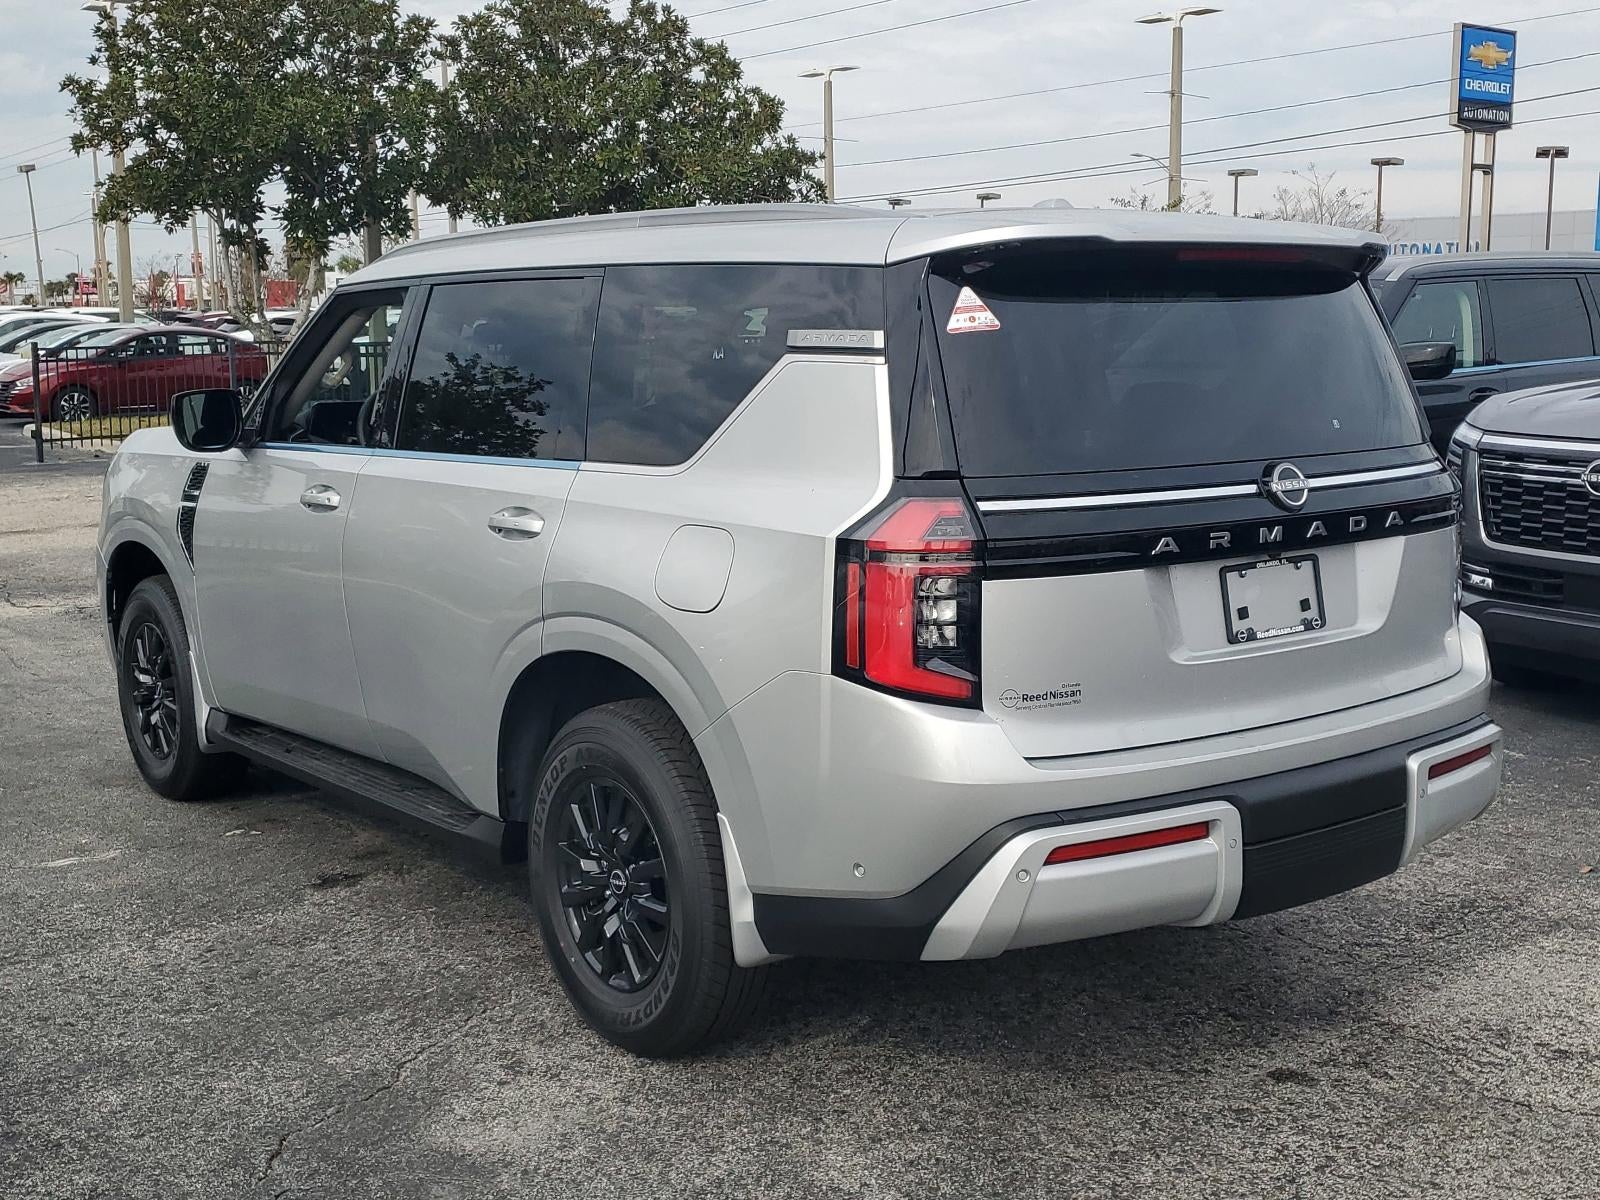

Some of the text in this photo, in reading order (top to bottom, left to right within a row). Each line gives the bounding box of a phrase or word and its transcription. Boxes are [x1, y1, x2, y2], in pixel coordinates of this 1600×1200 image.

[1465, 77, 1511, 95] CHEVROLET
[1463, 106, 1510, 122] AUTONATION
[801, 333, 869, 343] ARMADA
[1272, 479, 1310, 491] NISSAN
[1581, 474, 1600, 482] NIS
[1151, 510, 1404, 556] ARMADA
[1022, 688, 1082, 703] Reed Nissan
[533, 754, 568, 852] DUNLOP
[612, 928, 681, 1027] GRANDTR
